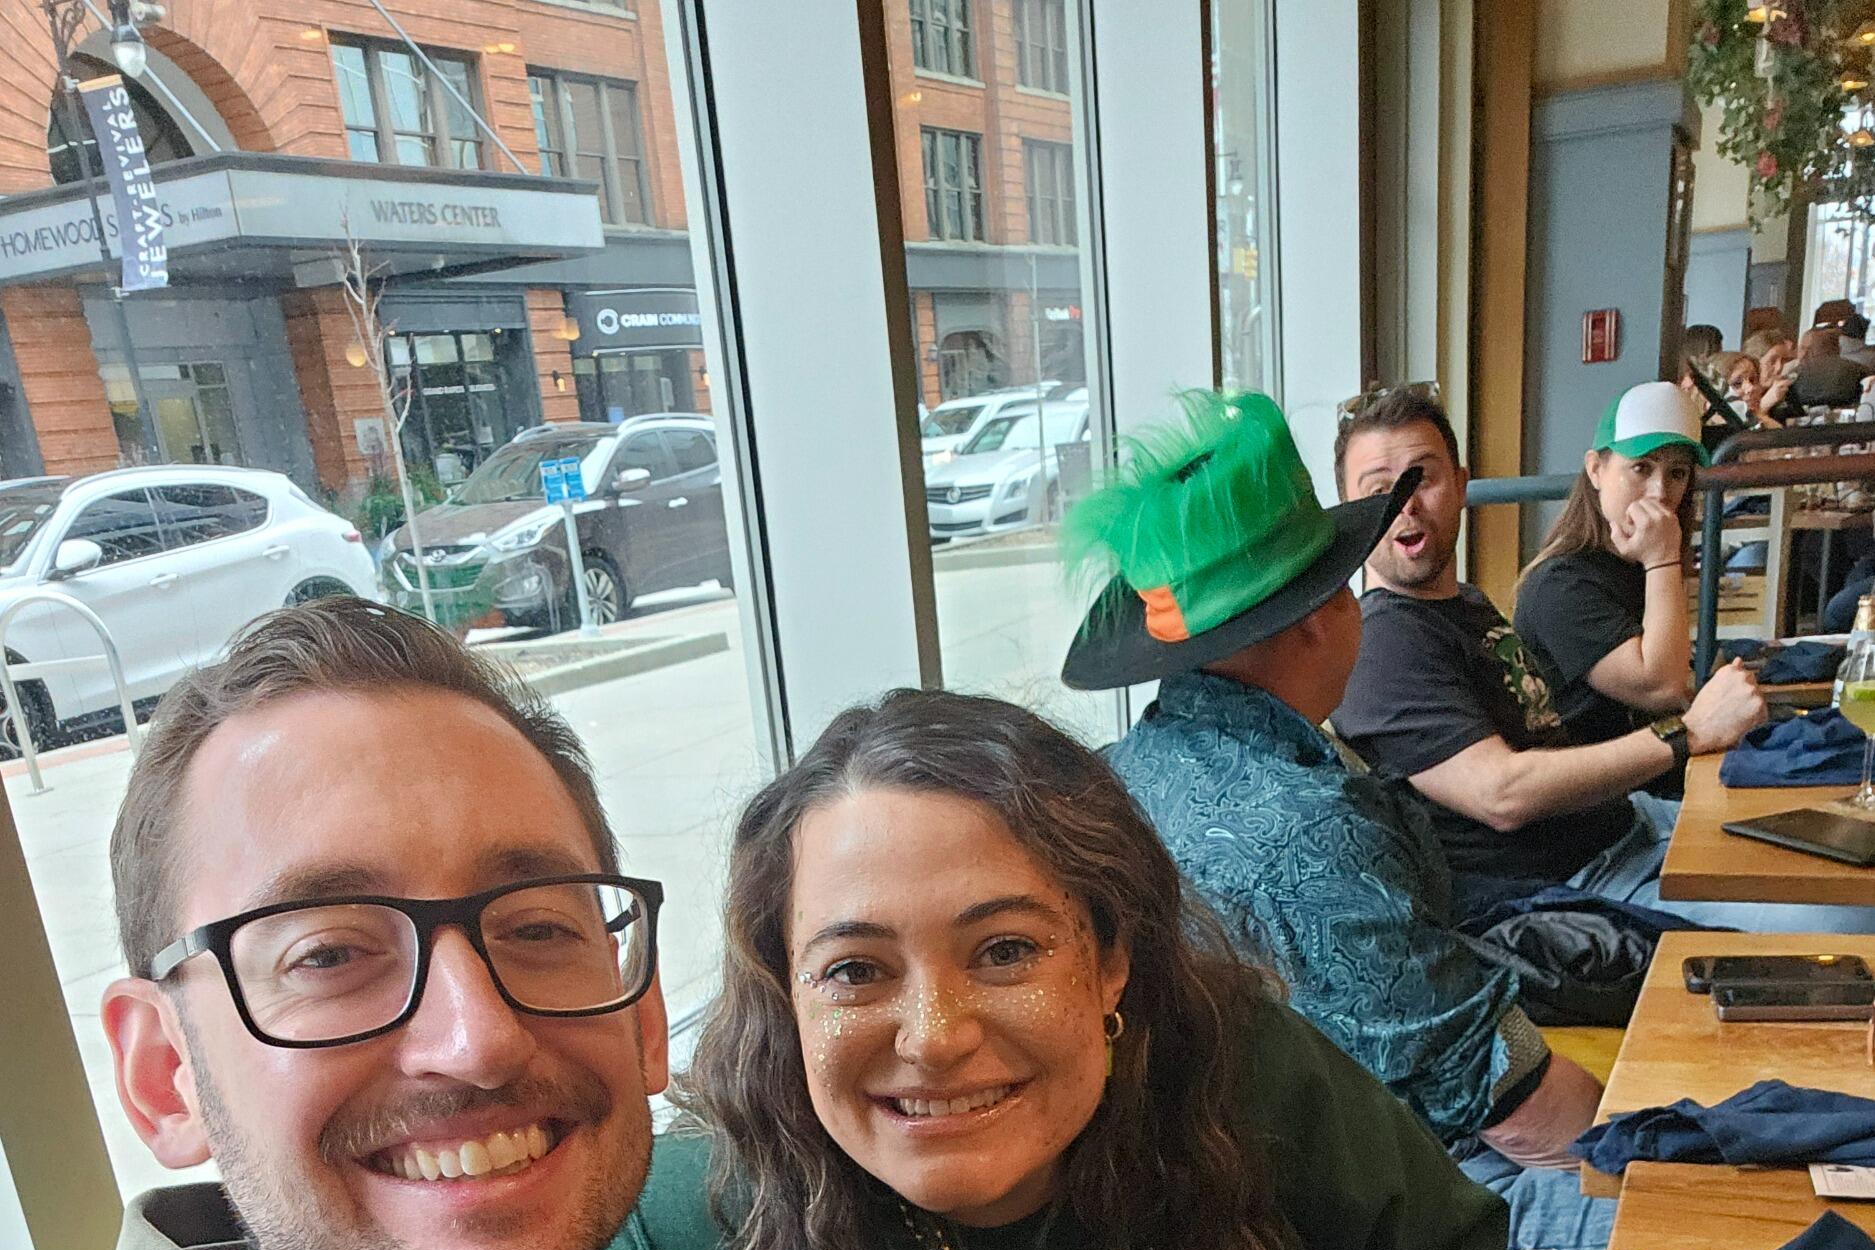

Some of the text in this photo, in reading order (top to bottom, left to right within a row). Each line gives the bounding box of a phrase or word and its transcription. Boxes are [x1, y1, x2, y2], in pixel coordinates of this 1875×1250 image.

[110, 87, 168, 281] JEWELERS
[178, 211, 189, 226] by
[191, 206, 223, 222] Hilton
[370, 200, 501, 228] WATERS CENTER
